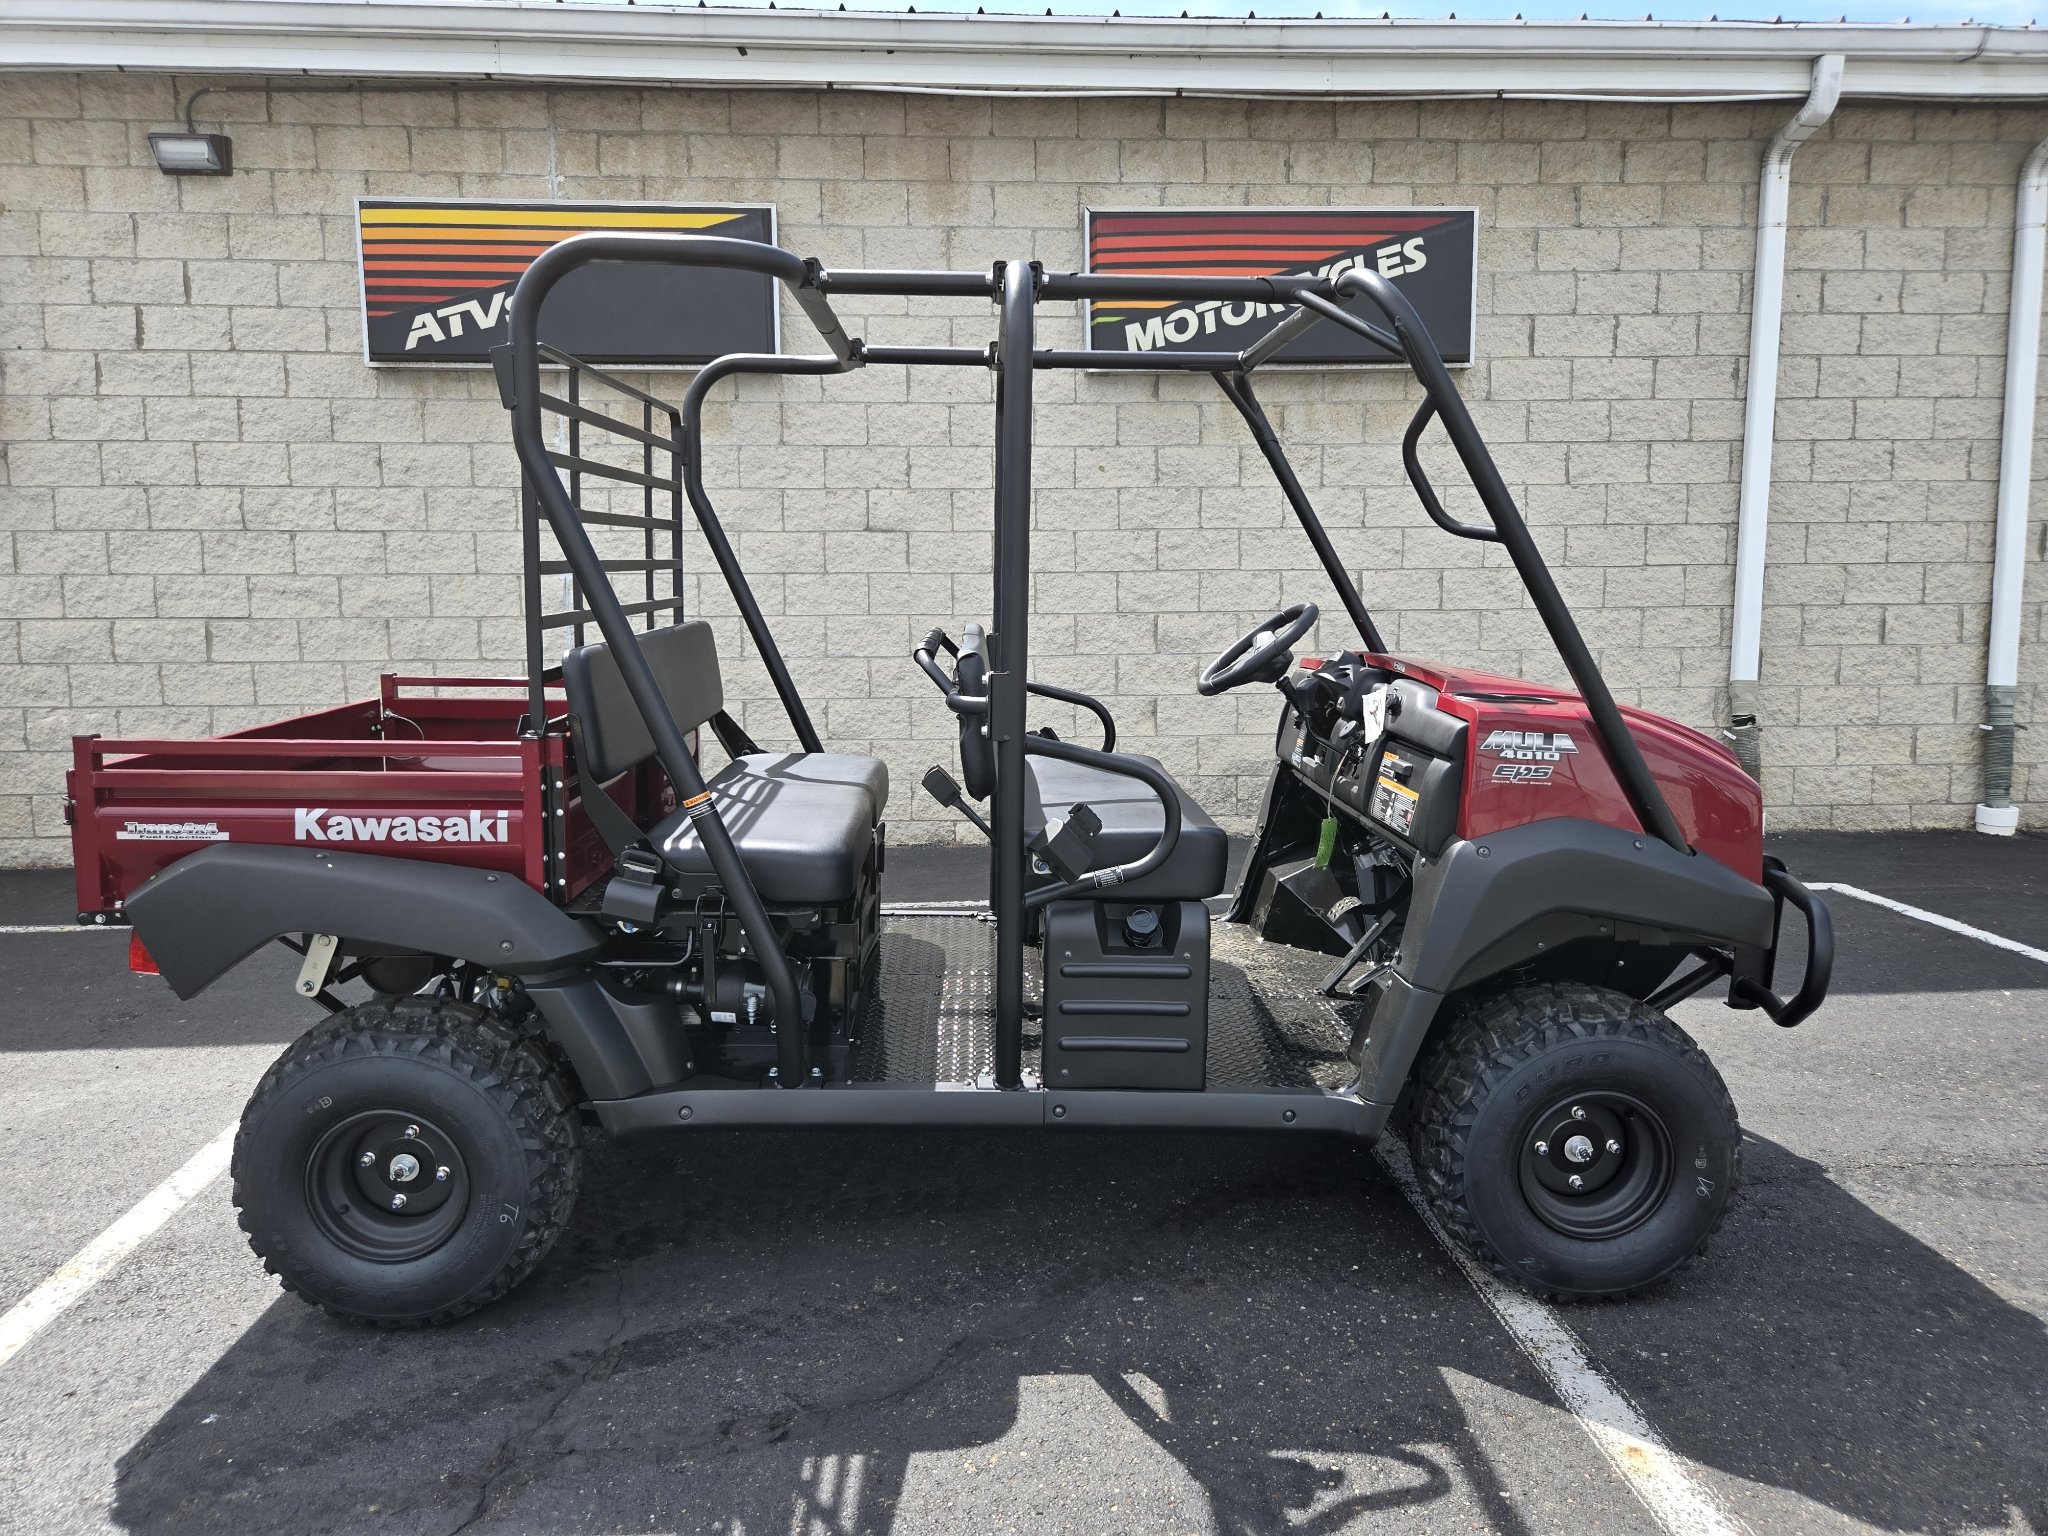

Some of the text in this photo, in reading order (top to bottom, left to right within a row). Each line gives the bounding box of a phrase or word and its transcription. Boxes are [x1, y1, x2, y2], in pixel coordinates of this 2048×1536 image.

[1125, 237, 1427, 352] MOTORCES
[1480, 730, 1579, 753] MULE
[1500, 750, 1560, 760] 4010
[295, 808, 509, 843] Kawasaki
